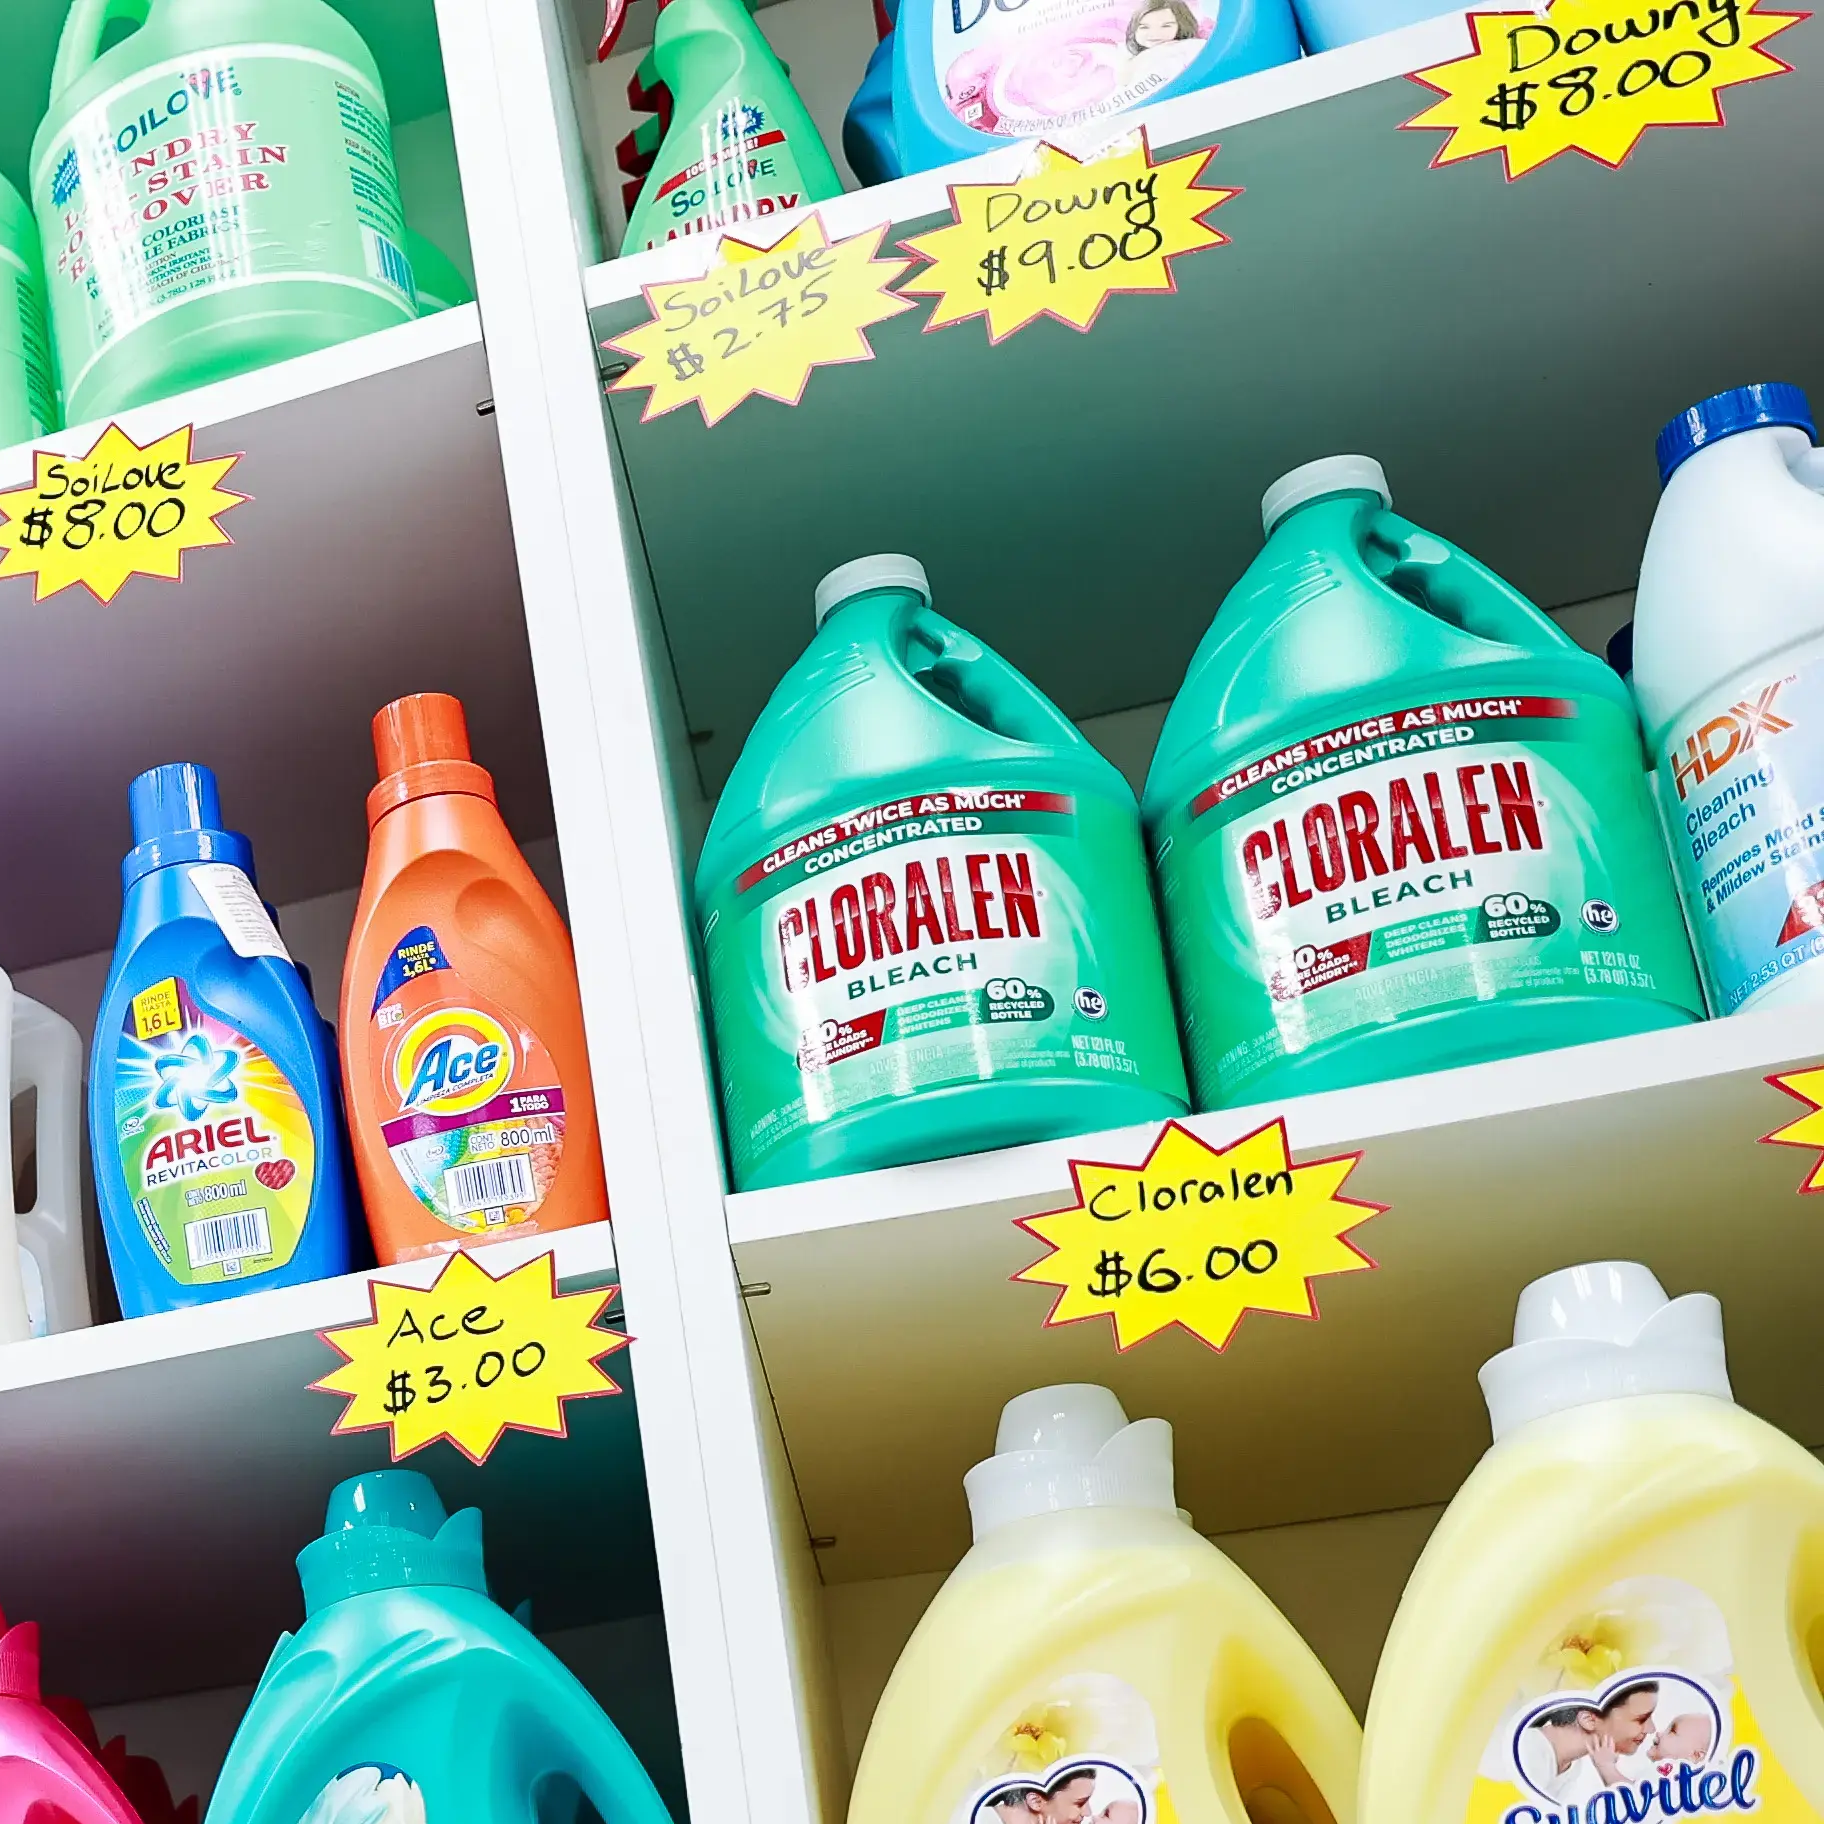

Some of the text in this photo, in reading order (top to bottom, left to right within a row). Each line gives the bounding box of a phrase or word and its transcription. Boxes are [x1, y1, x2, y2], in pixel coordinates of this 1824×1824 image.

[1507, 0, 1741, 73] Downy
[1480, 50, 1712, 131] $8.00
[985, 172, 1160, 232] Downy
[978, 223, 1163, 296] $9.00
[666, 273, 831, 384] $2.75
[20, 498, 186, 551] $8.00
[1220, 710, 1438, 799] CLEANS TWICE AS
[1271, 725, 1474, 796] CONCENTRATED
[1683, 767, 1777, 838] Cleaning
[1692, 801, 1757, 862] Bleach
[763, 796, 950, 874] CLEANS TWICE AS
[804, 814, 984, 874] CONCENTRATED
[1241, 759, 1546, 922] CLORALEN
[778, 852, 1042, 995] CLORALEN
[1324, 868, 1473, 924] BLEACH
[1488, 915, 1551, 930] RECYCLED
[397, 941, 435, 961] RINDE
[1490, 924, 1537, 938] BOTTLE
[846, 952, 978, 1001] BLEACH
[989, 1000, 1046, 1013] RECYCLED
[990, 1009, 1033, 1021] BOTTLE
[144, 1116, 272, 1171] ARIEL
[500, 1124, 554, 1149] 800 ml
[1087, 1168, 1294, 1222] Cloralen
[1087, 1239, 1278, 1299] $6.00
[386, 1305, 504, 1349] Ace
[383, 1341, 546, 1416] $3.00
